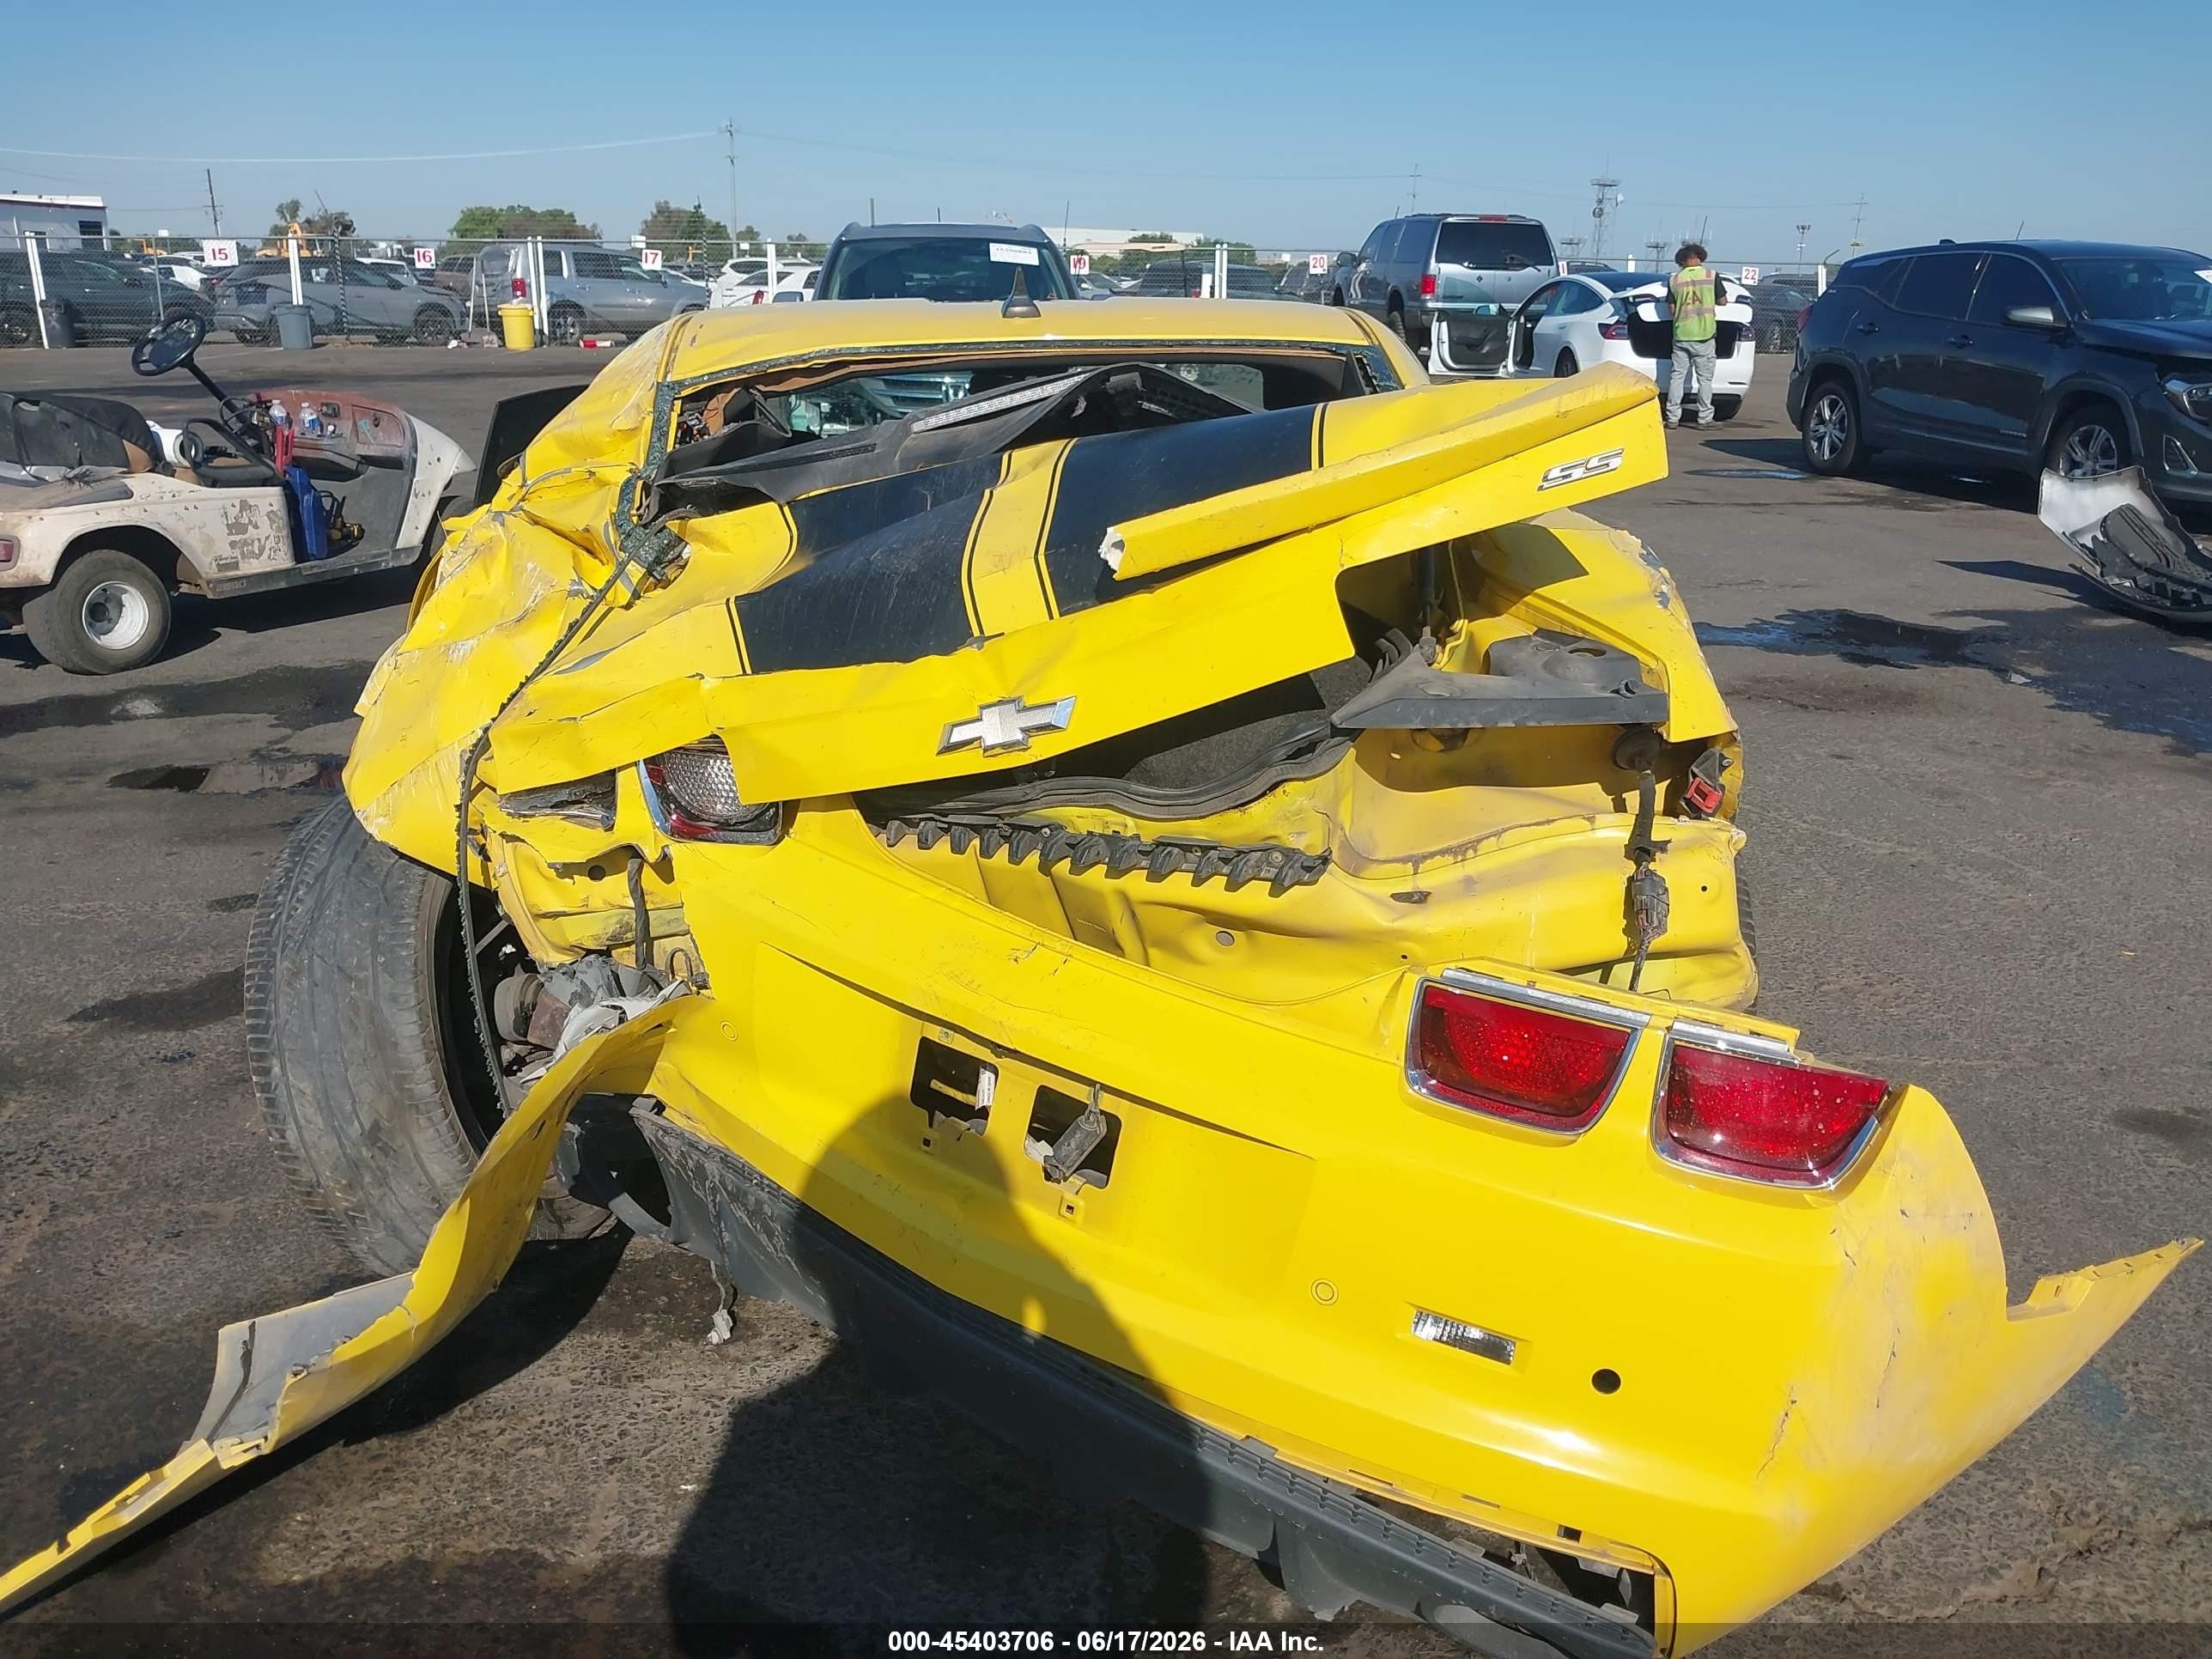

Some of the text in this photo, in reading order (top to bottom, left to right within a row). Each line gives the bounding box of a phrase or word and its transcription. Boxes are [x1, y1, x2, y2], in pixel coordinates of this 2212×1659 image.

[212, 248, 228, 261] 15
[417, 250, 432, 263] 16
[645, 252, 659, 264] 17
[1312, 256, 1325, 268] 20
[1744, 268, 1757, 281] 22
[1536, 447, 1626, 492] SS
